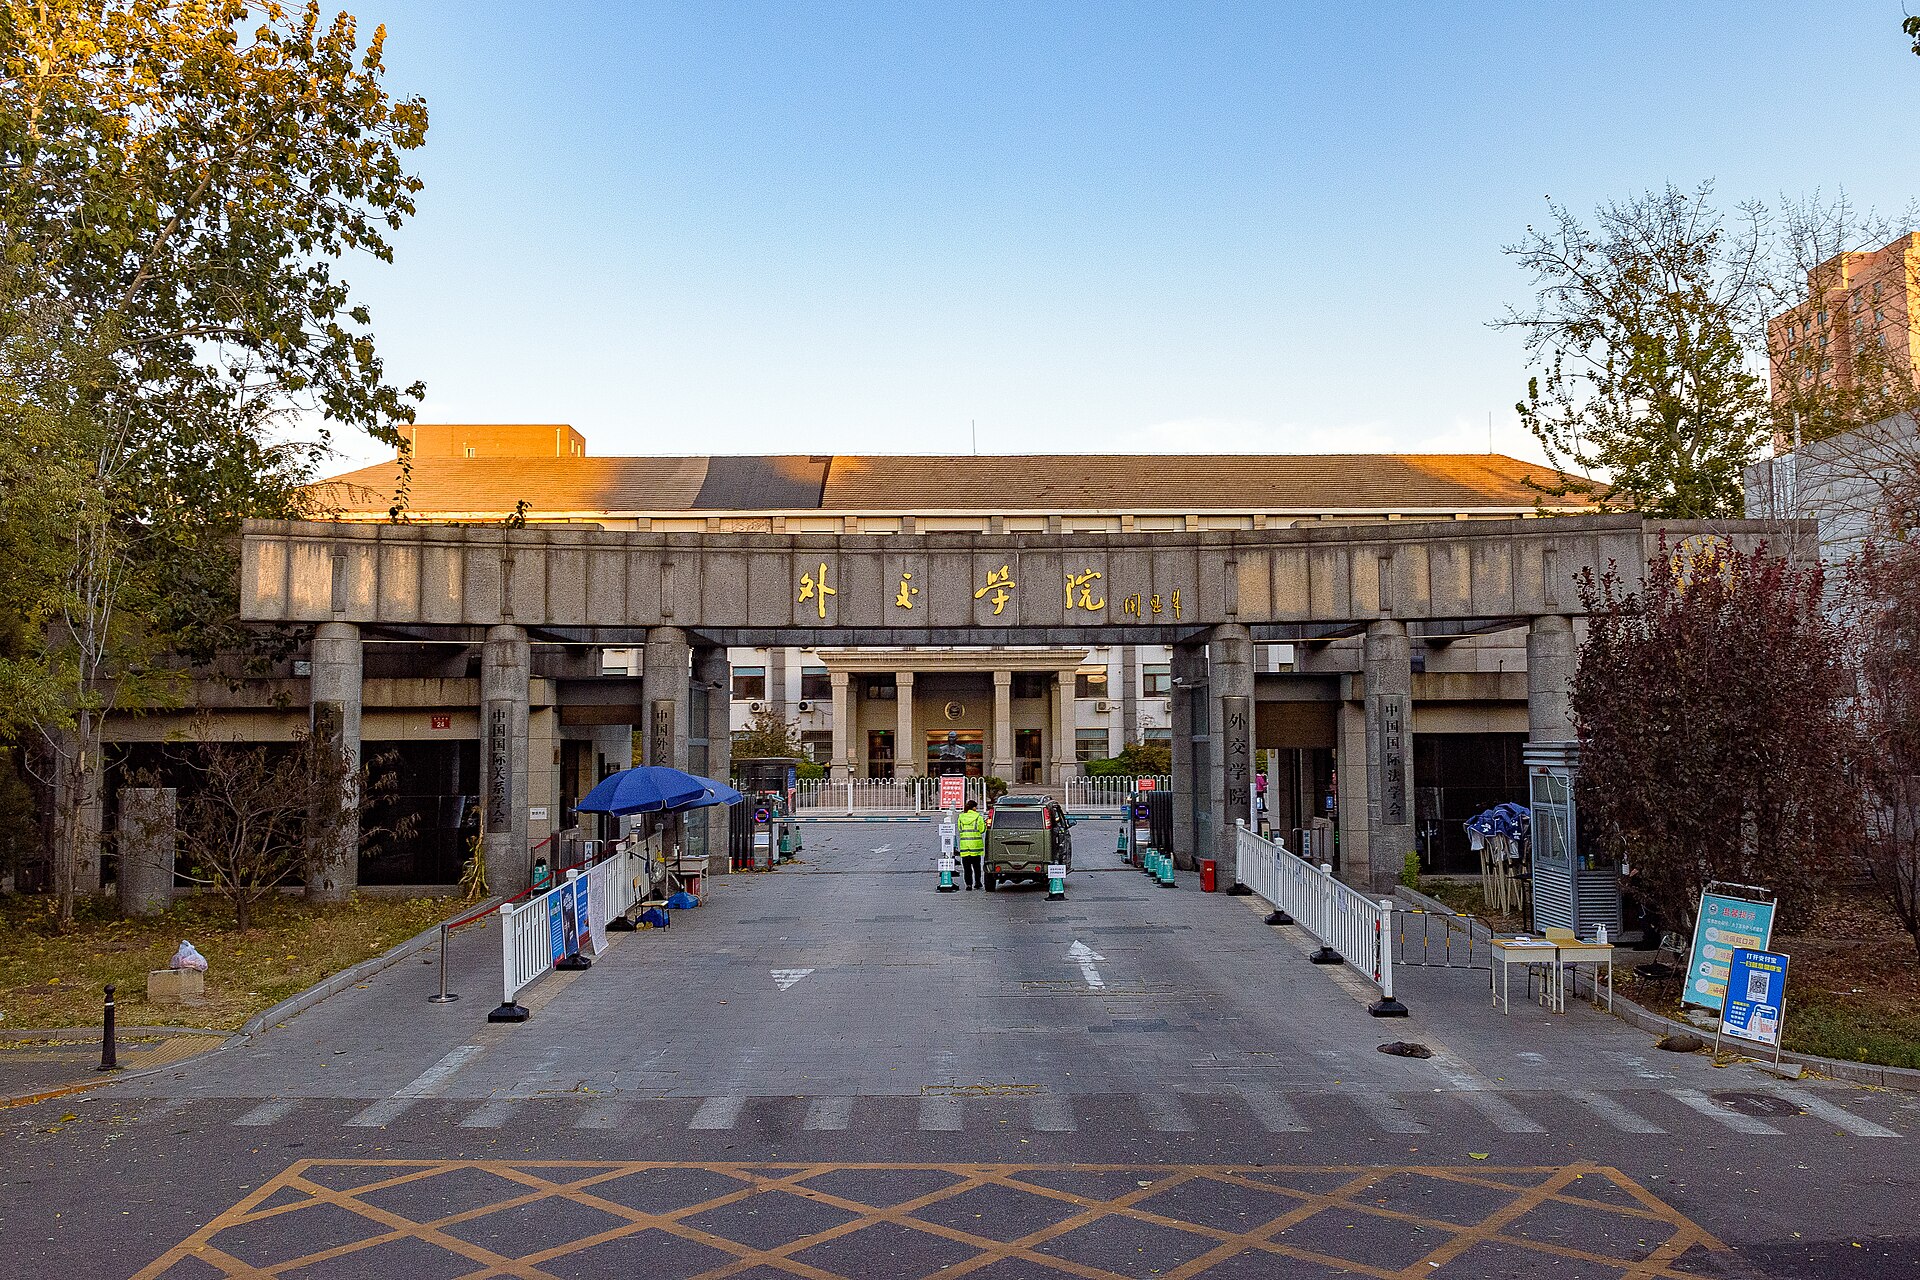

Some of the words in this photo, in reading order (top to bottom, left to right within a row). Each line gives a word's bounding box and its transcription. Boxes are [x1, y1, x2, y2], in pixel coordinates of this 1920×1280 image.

[798, 563, 1105, 618] 外交学院
[492, 709, 506, 823] 中国国际关系学会
[1228, 712, 1247, 805] 外交学院
[1385, 703, 1401, 816] 中国国际法学会
[1746, 953, 1777, 964] 打开支付宝
